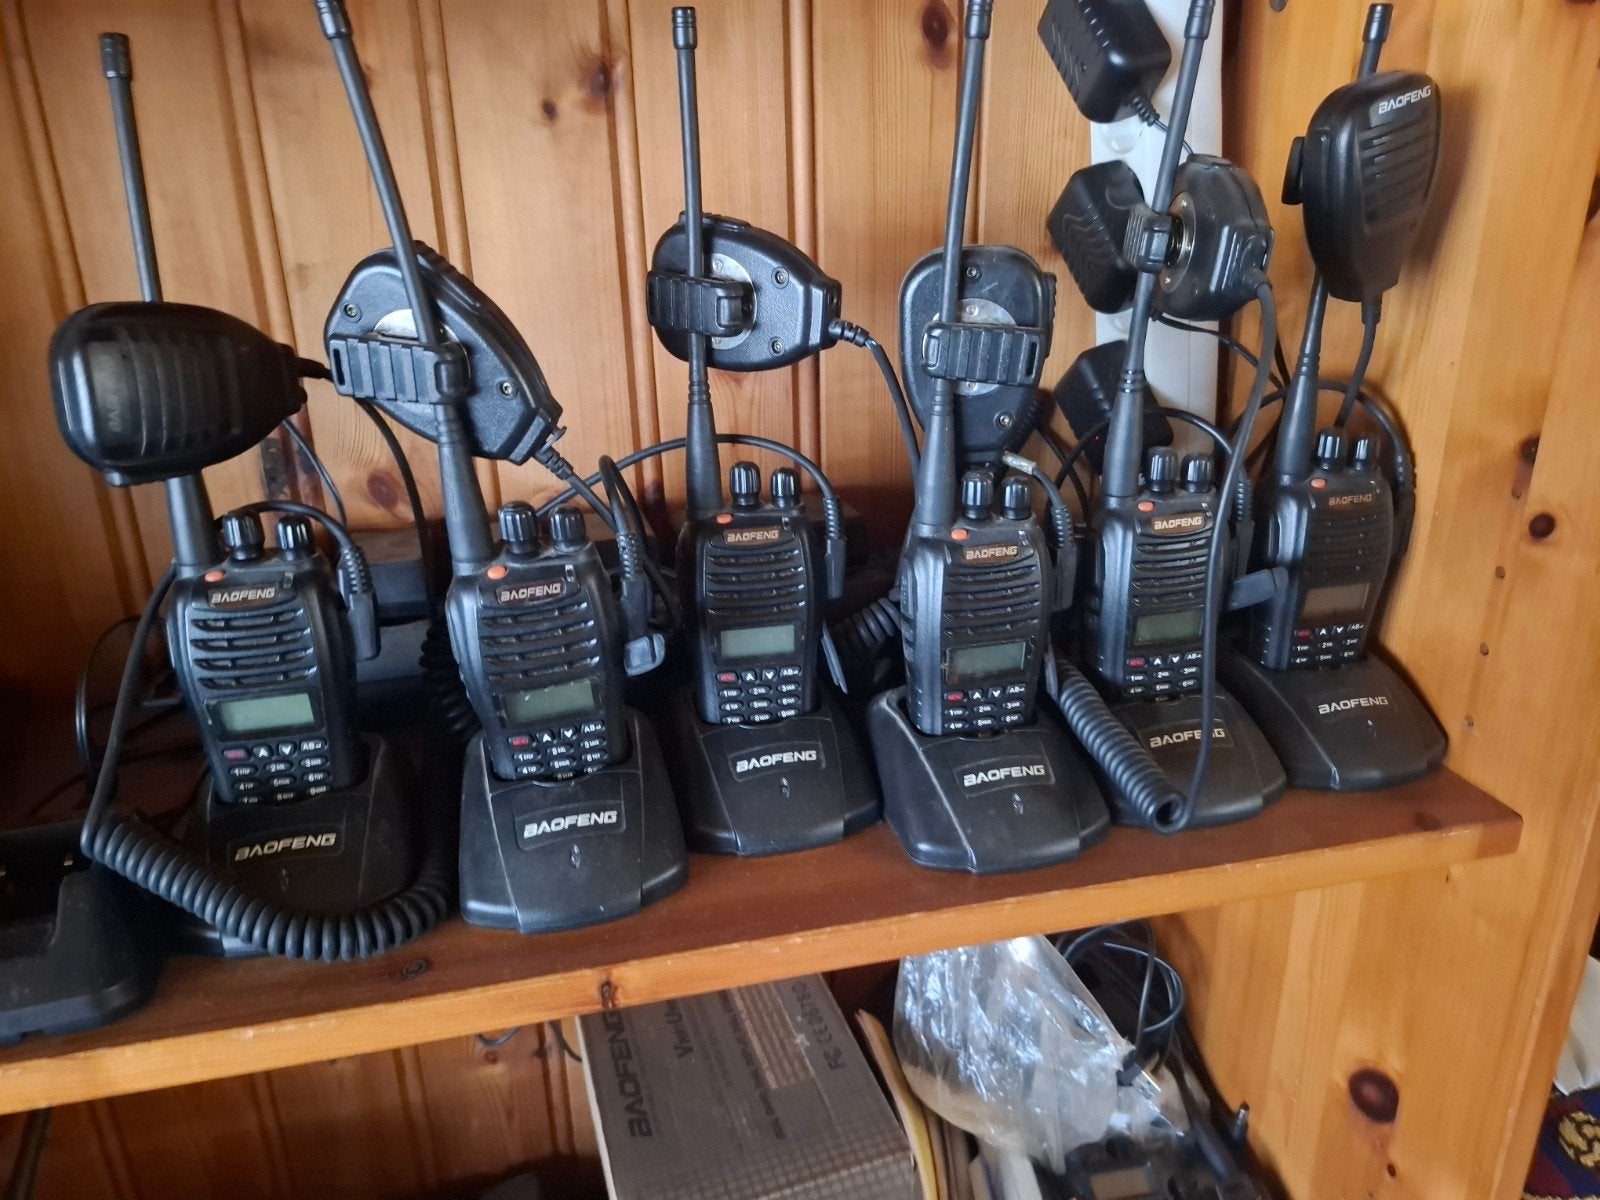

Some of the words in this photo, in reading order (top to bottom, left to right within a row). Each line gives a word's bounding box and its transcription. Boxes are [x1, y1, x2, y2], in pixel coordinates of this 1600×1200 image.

[1379, 85, 1431, 115] BAOFENG
[1328, 493, 1372, 506] BAOFENG
[1154, 516, 1202, 530] BAOFENG
[727, 529, 779, 543] BAOFENG
[966, 545, 1018, 560] BAOFENG
[211, 586, 276, 604] BAOFENG
[500, 582, 561, 602] BAOFENG
[1318, 696, 1389, 715] BAOFENG
[1149, 728, 1226, 748] BAOFEG
[736, 750, 817, 773] BAOFENG
[963, 764, 1046, 787] BAOFENG
[523, 810, 618, 839] BAOFENG
[234, 832, 337, 862] BAOFENG
